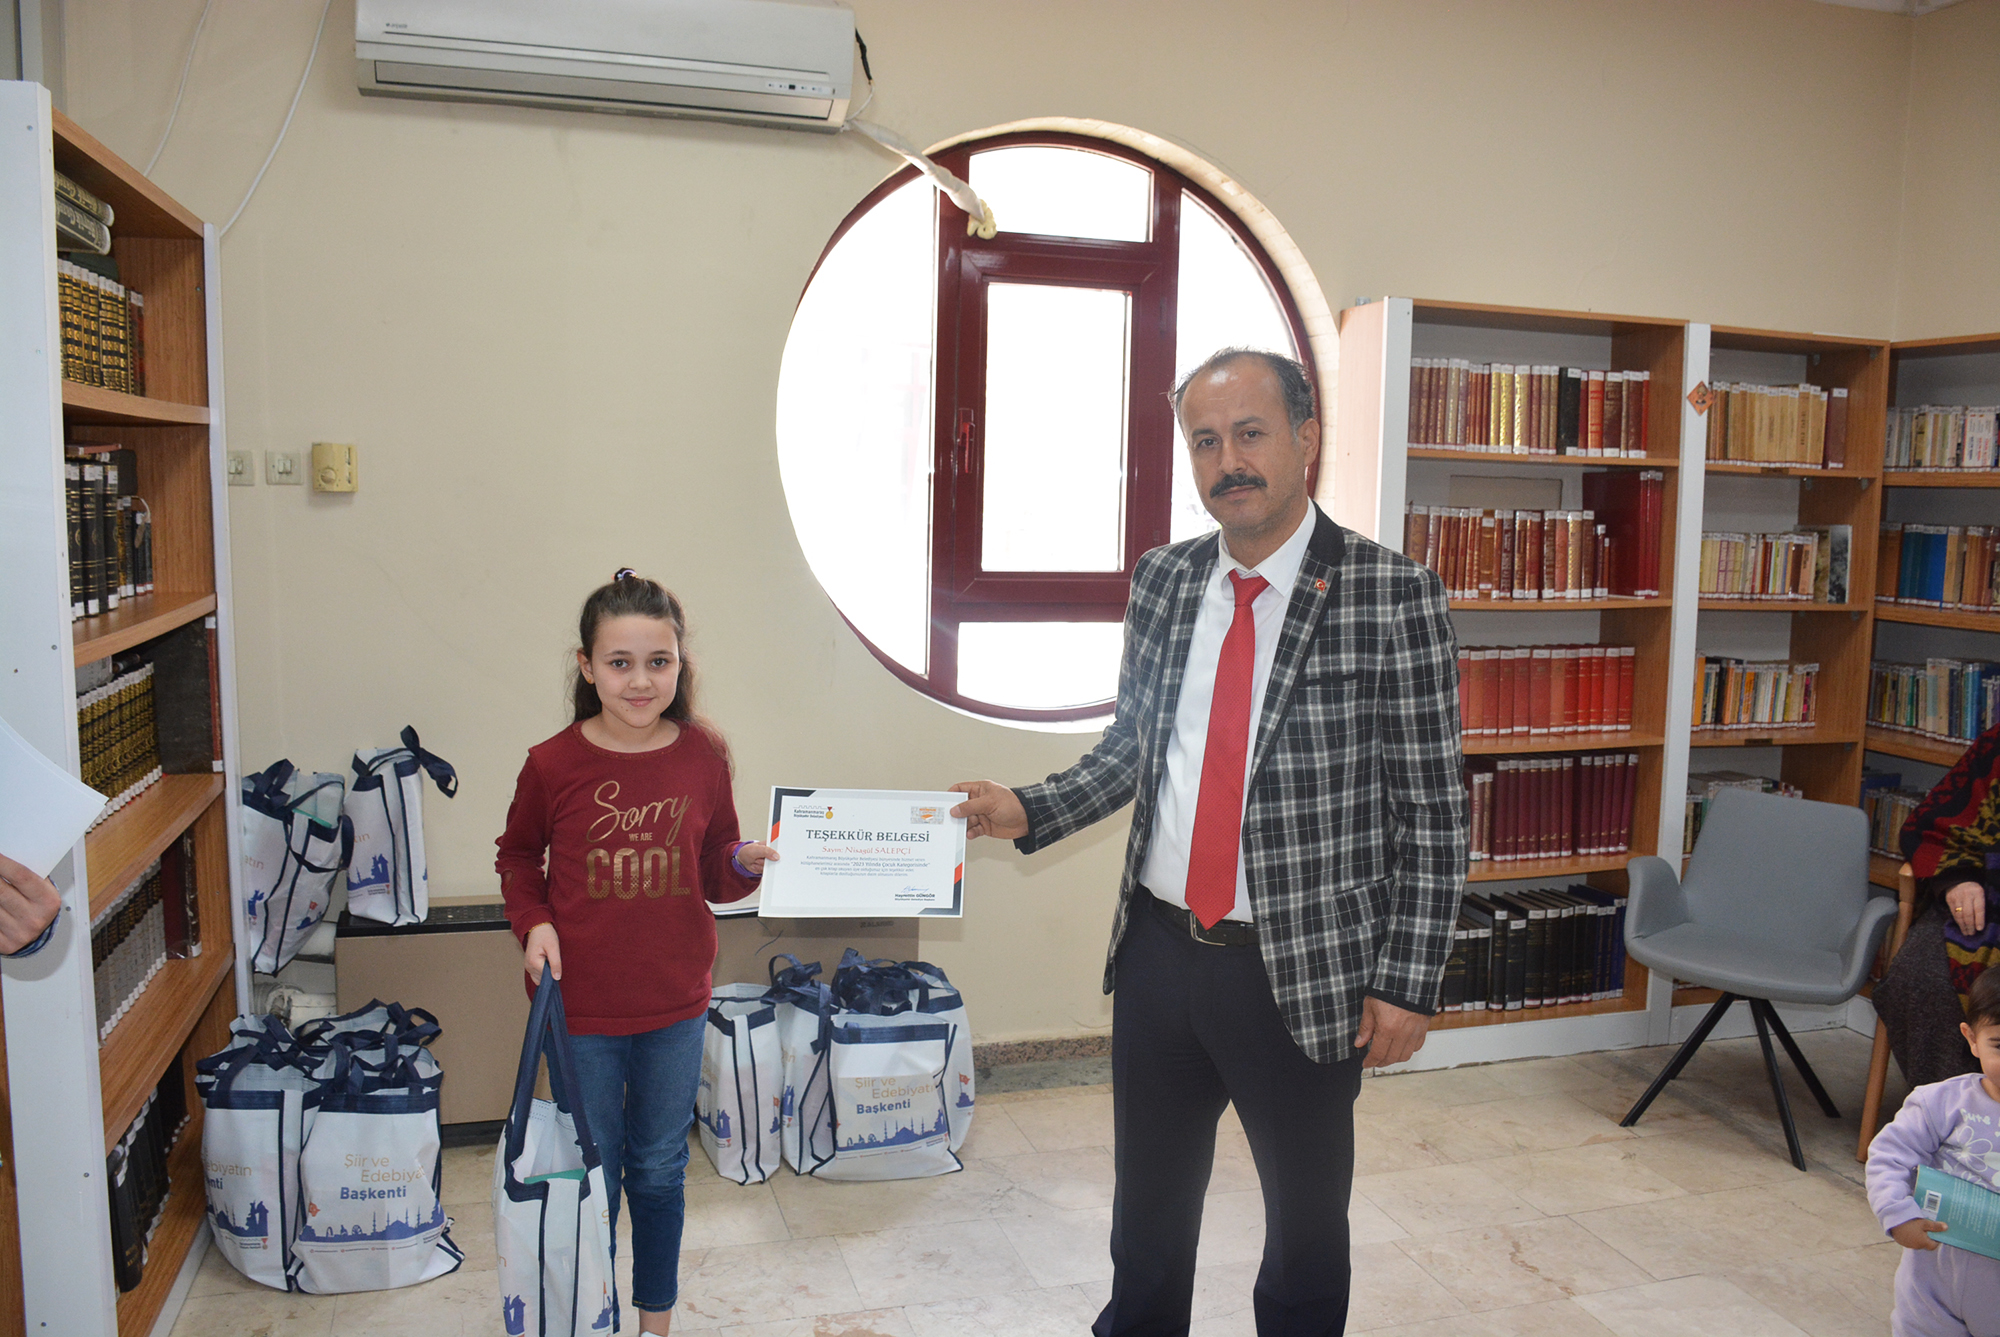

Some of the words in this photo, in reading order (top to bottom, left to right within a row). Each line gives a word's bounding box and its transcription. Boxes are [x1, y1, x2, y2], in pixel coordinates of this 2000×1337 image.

[586, 780, 692, 846] Sorry
[629, 833, 639, 841] WE
[640, 832, 653, 841] ARE
[806, 829, 872, 842] TEŞEKKÜR
[876, 831, 930, 843] BELGESİ
[845, 846, 873, 855] Nisagül
[875, 847, 911, 855] SALEPÇİ
[586, 846, 691, 899] COOL
[855, 1077, 876, 1089] Şiir
[881, 1077, 896, 1086] ve
[856, 1098, 911, 1114] Başkenti
[344, 1153, 368, 1168] Şiir
[371, 1157, 390, 1168] ve
[340, 1185, 407, 1201] Başkenti
